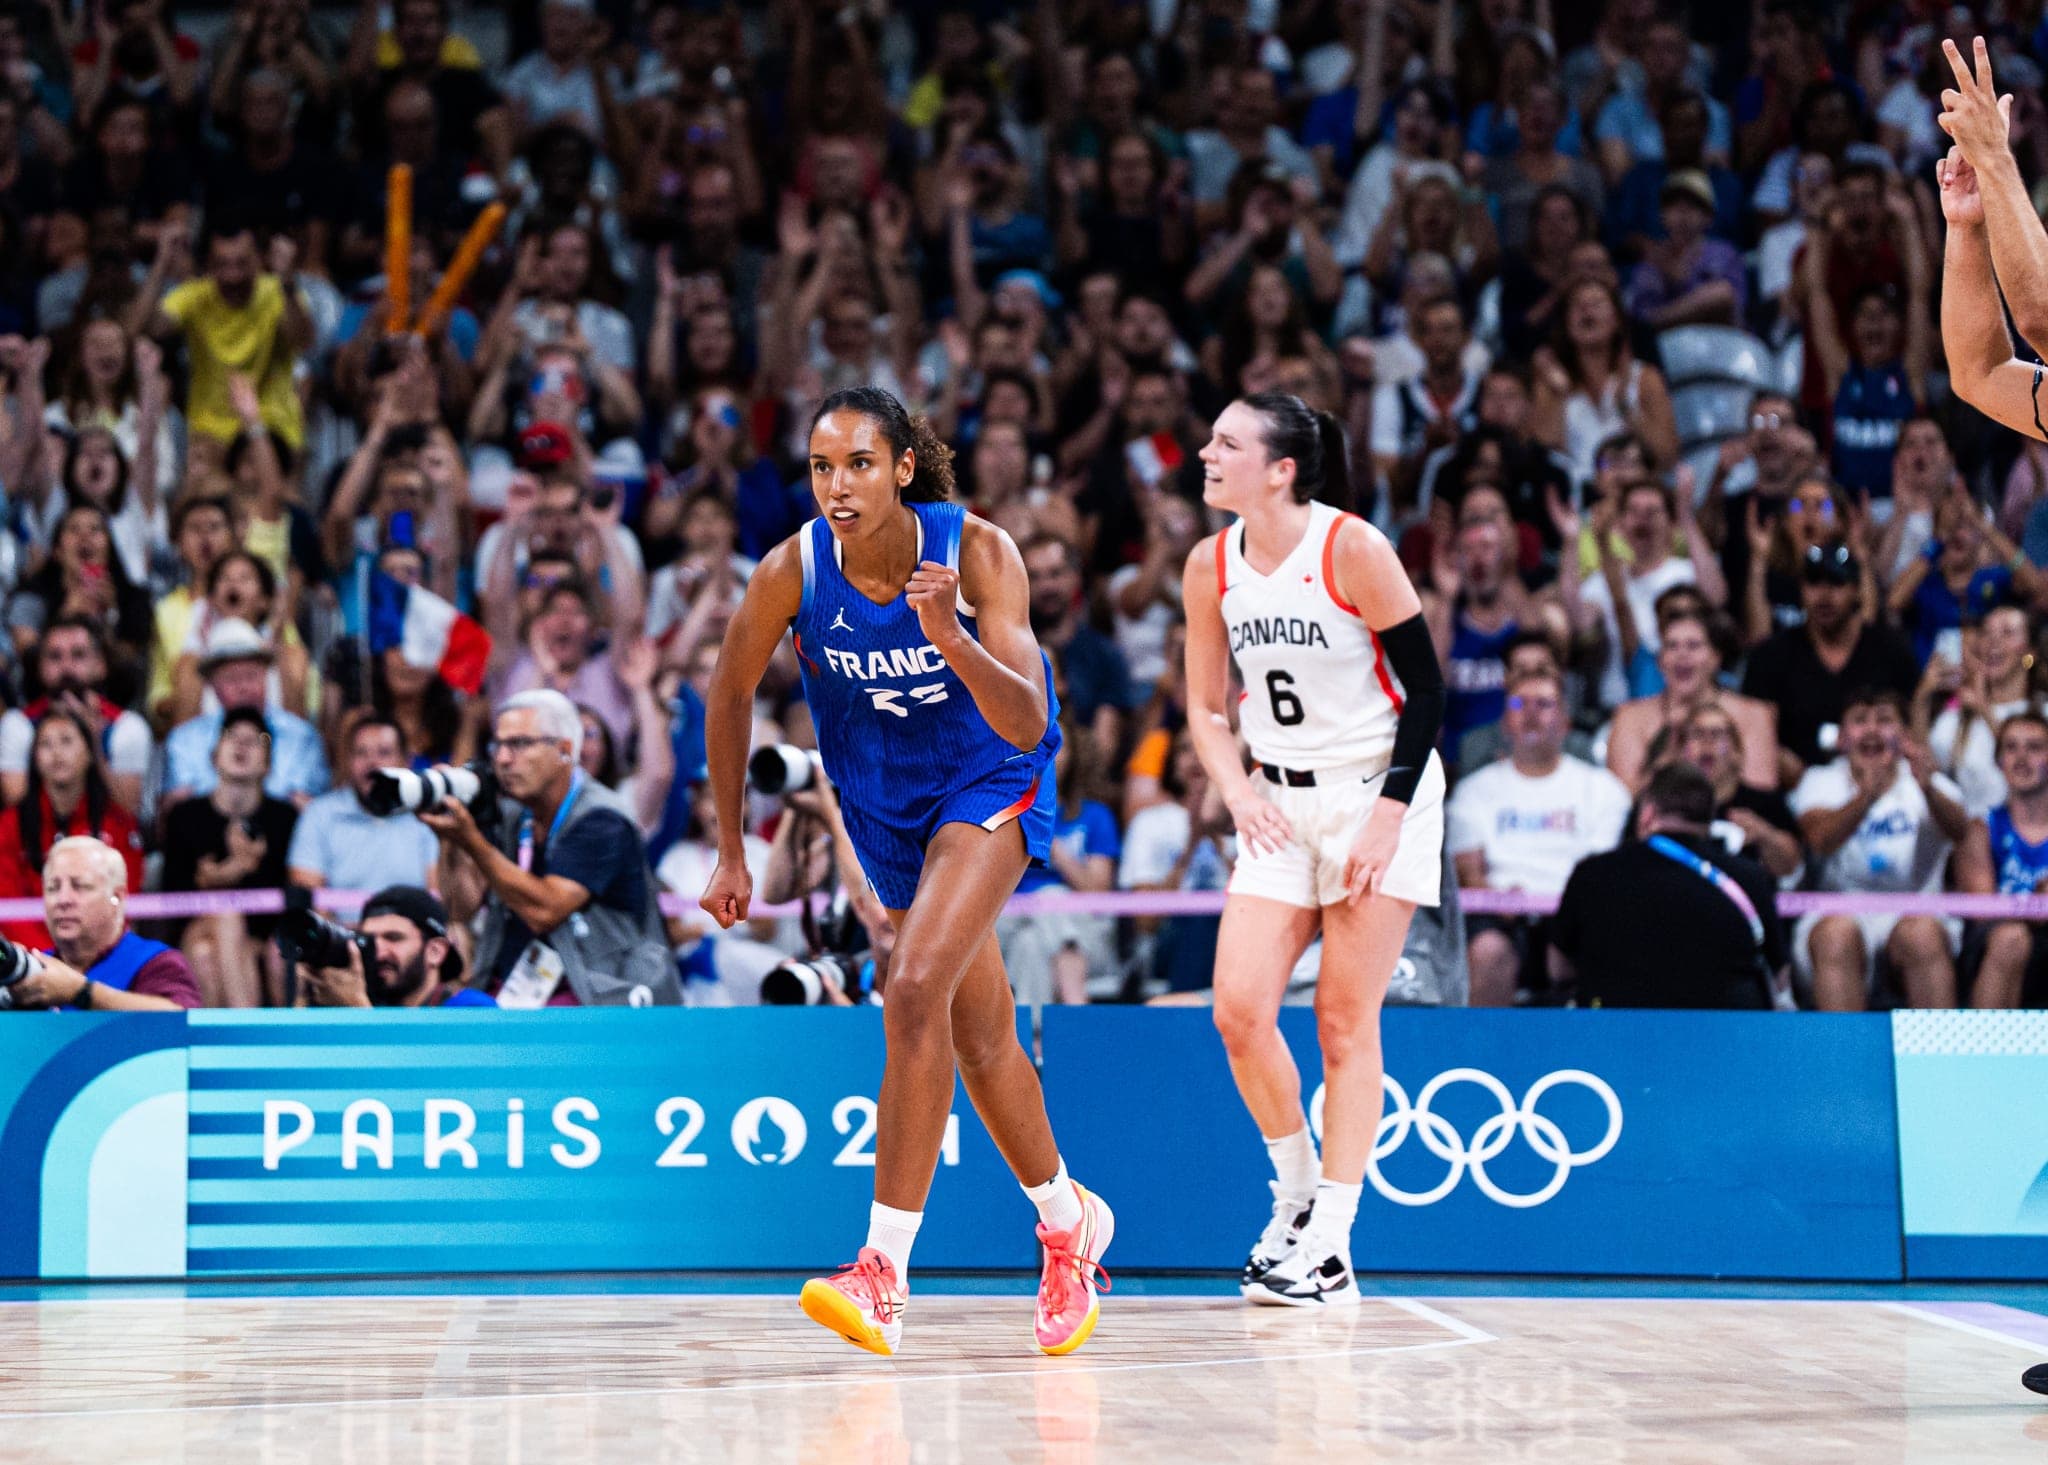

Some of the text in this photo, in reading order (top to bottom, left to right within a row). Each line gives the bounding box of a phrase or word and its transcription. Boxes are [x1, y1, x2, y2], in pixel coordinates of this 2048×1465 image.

[1231, 617, 1330, 653] CANADA
[823, 644, 949, 680] FRANC
[1265, 669, 1305, 726] 6
[654, 1096, 960, 1168] 202
